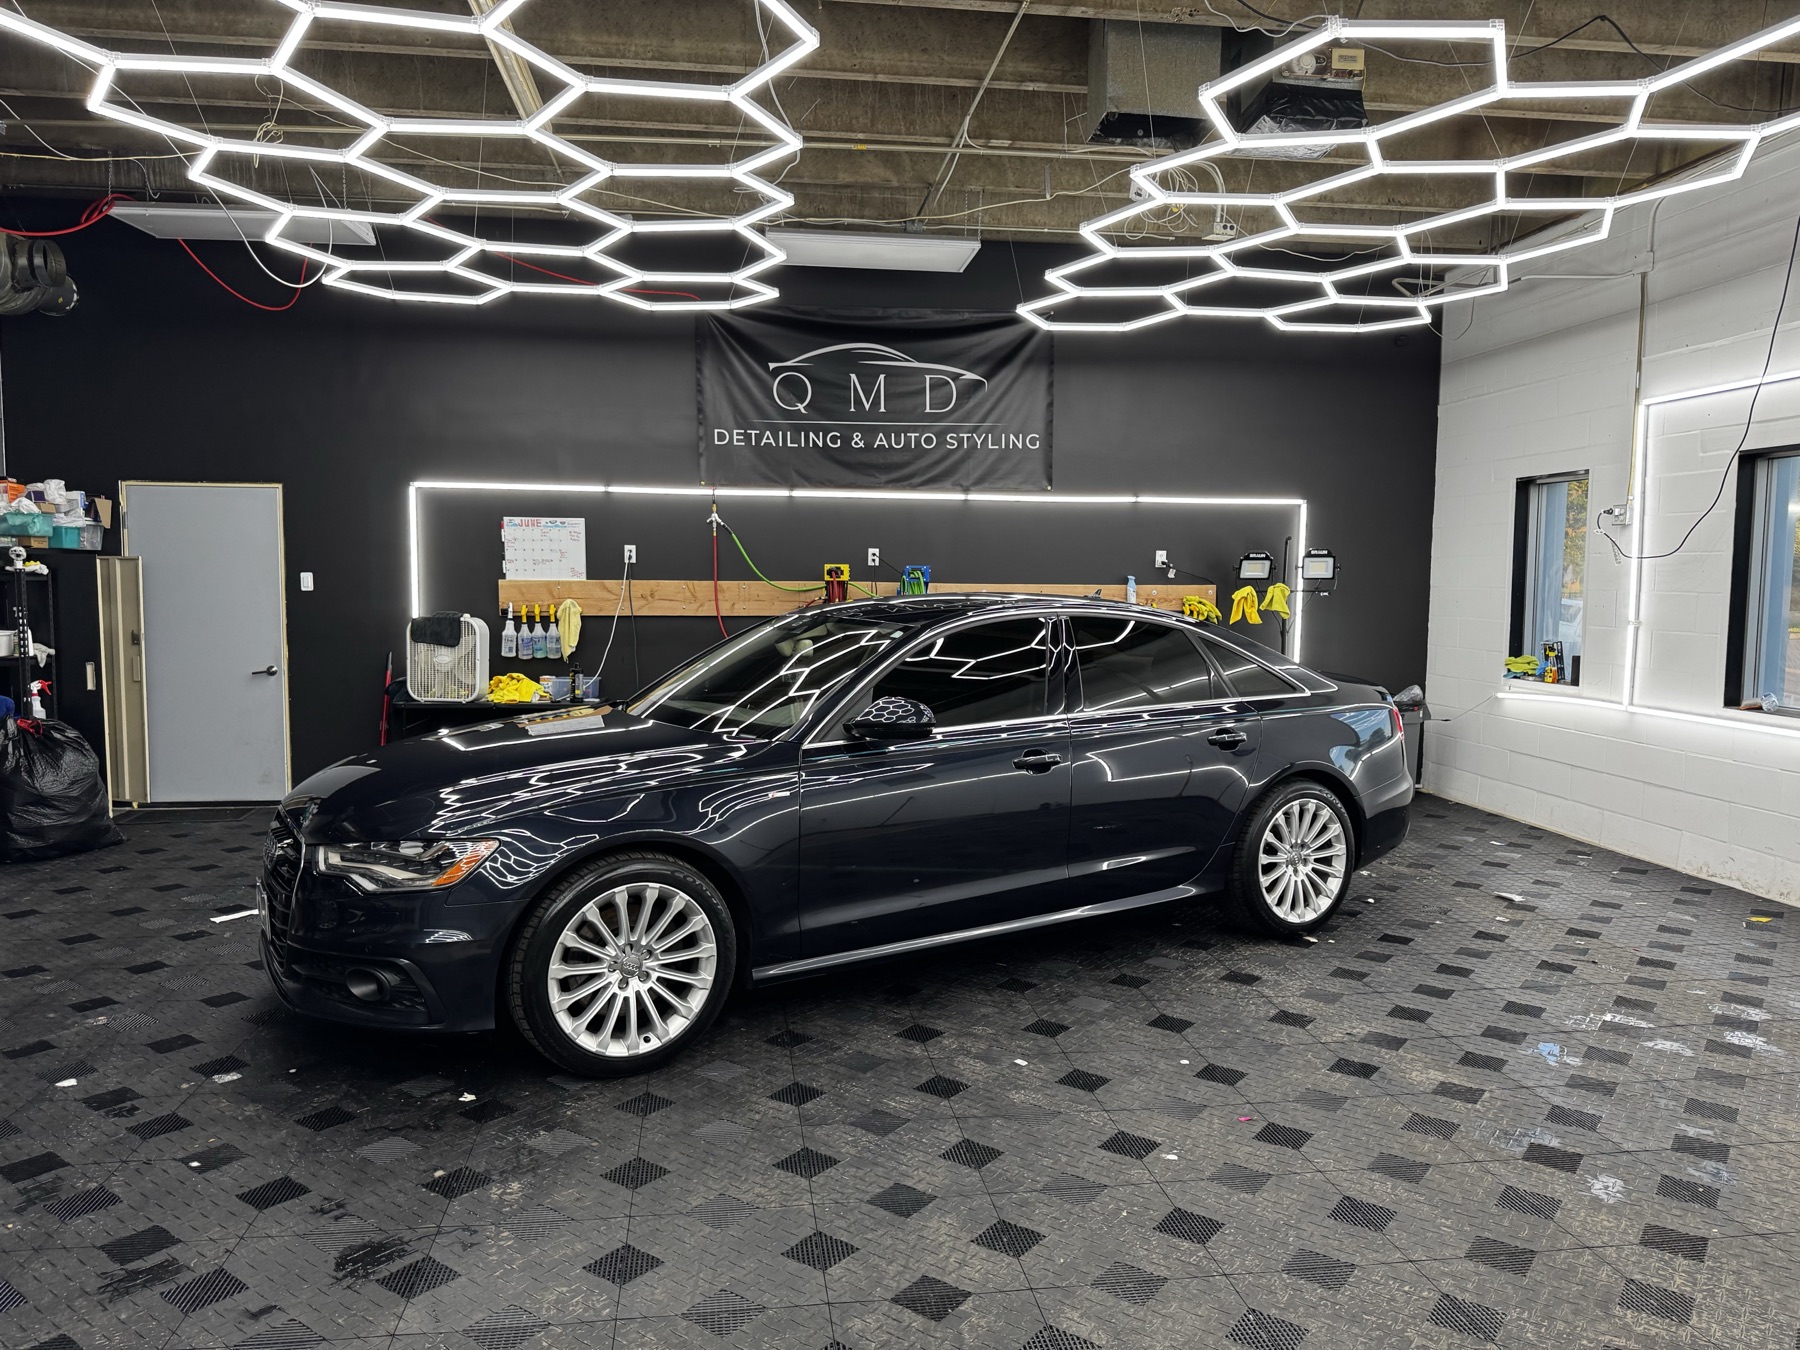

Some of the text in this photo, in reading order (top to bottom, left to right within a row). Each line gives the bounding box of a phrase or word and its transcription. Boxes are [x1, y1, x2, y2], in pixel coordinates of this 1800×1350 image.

[713, 428, 1040, 450] DETAILING & AUTO STYLING
[518, 518, 542, 528] JUNE
